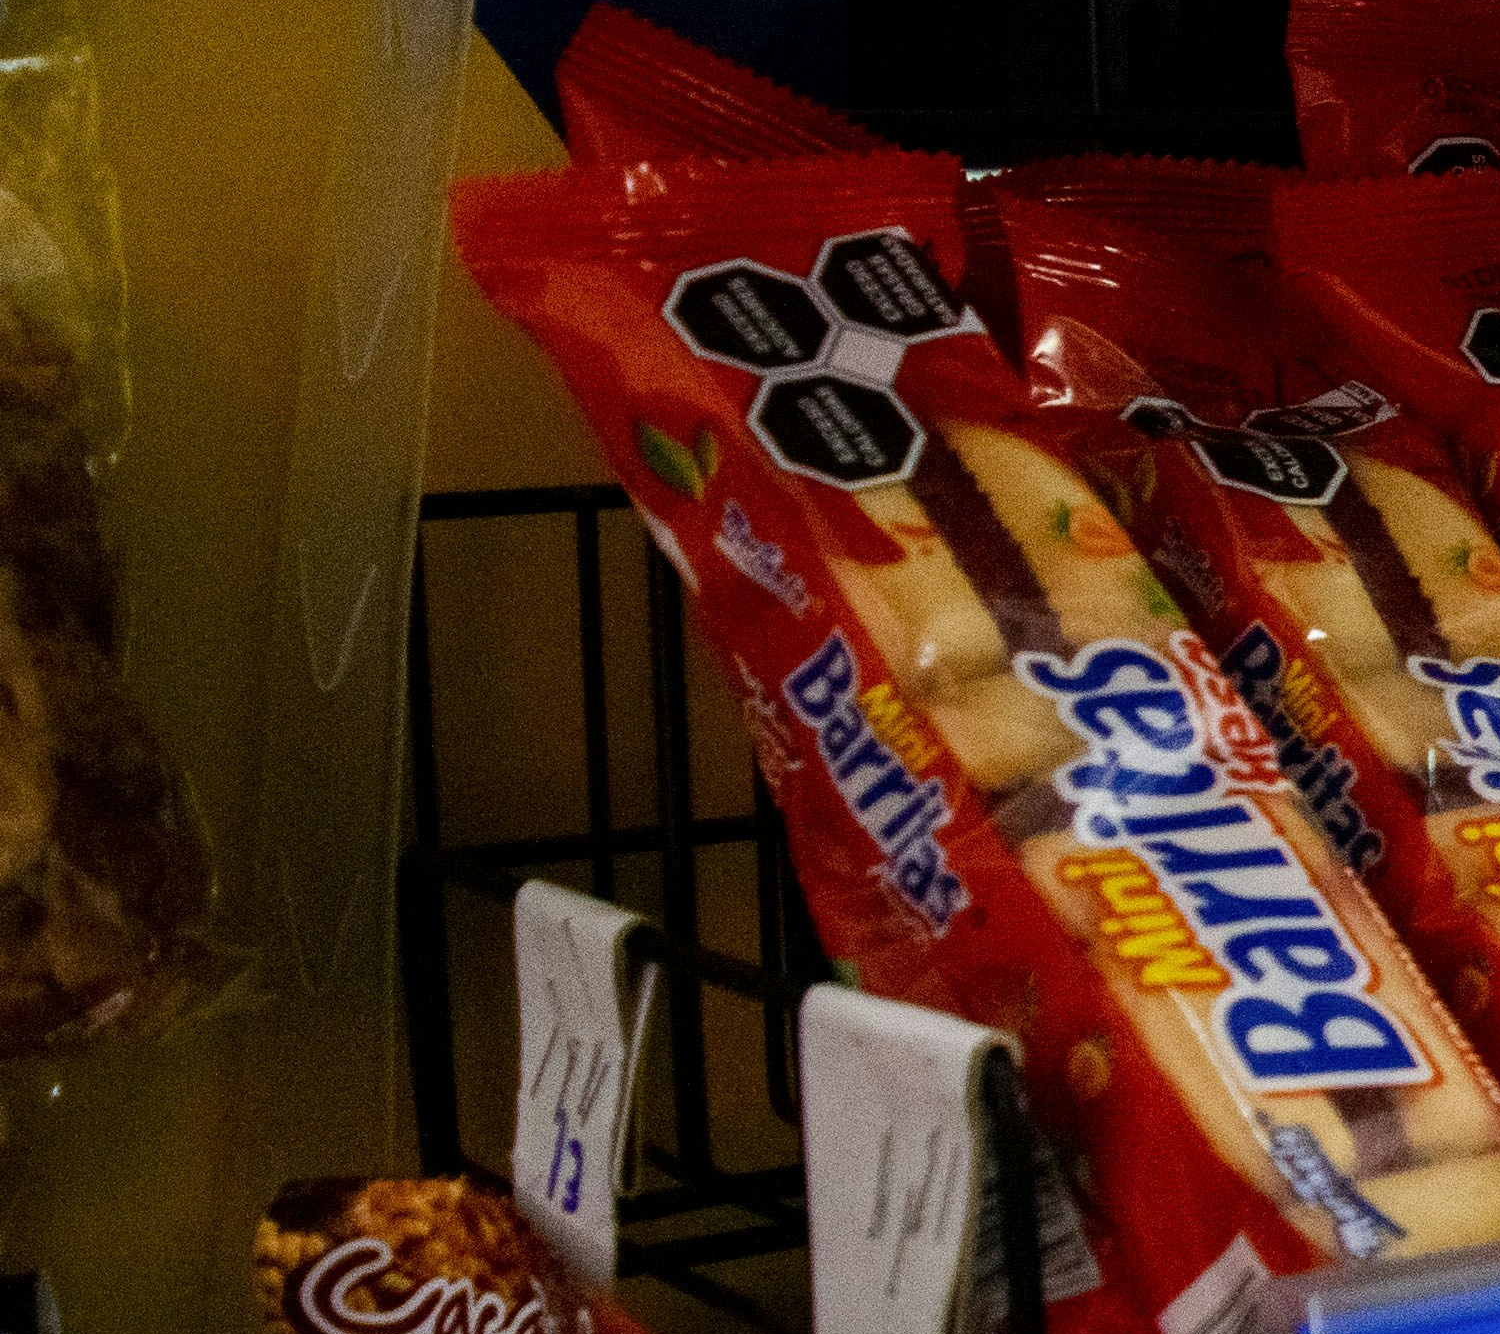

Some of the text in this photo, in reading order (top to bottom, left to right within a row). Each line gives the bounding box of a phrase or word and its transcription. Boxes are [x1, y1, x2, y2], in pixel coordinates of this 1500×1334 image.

[783, 624, 973, 940] Barritas
[858, 681, 944, 774] Mini
[1170, 627, 1286, 797] fresa
[1014, 635, 1434, 1089] Barritas
[1059, 850, 1231, 992] Mini
